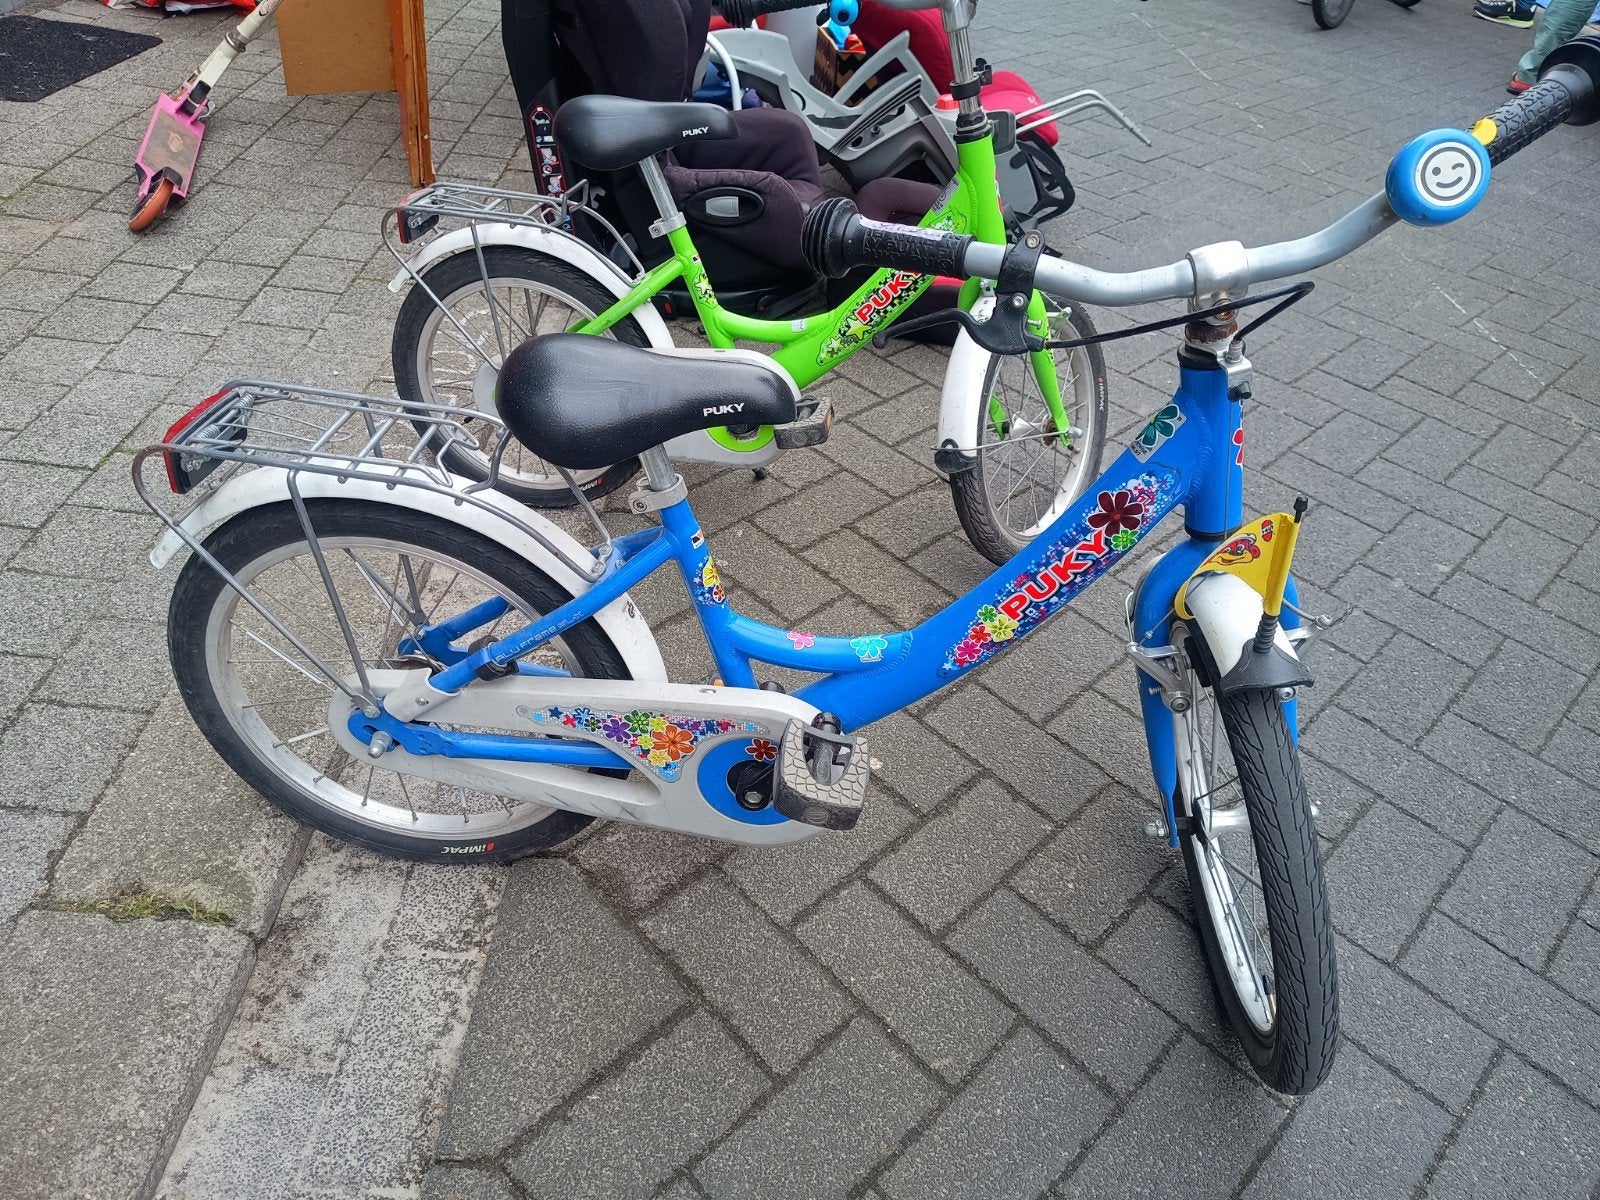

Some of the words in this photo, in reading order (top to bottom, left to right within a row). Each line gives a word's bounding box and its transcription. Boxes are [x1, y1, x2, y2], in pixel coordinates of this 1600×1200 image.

[682, 126, 709, 138] PUKY
[703, 402, 745, 417] PUKY
[999, 529, 1109, 621] PUKY
[440, 844, 487, 854] iMPAC
